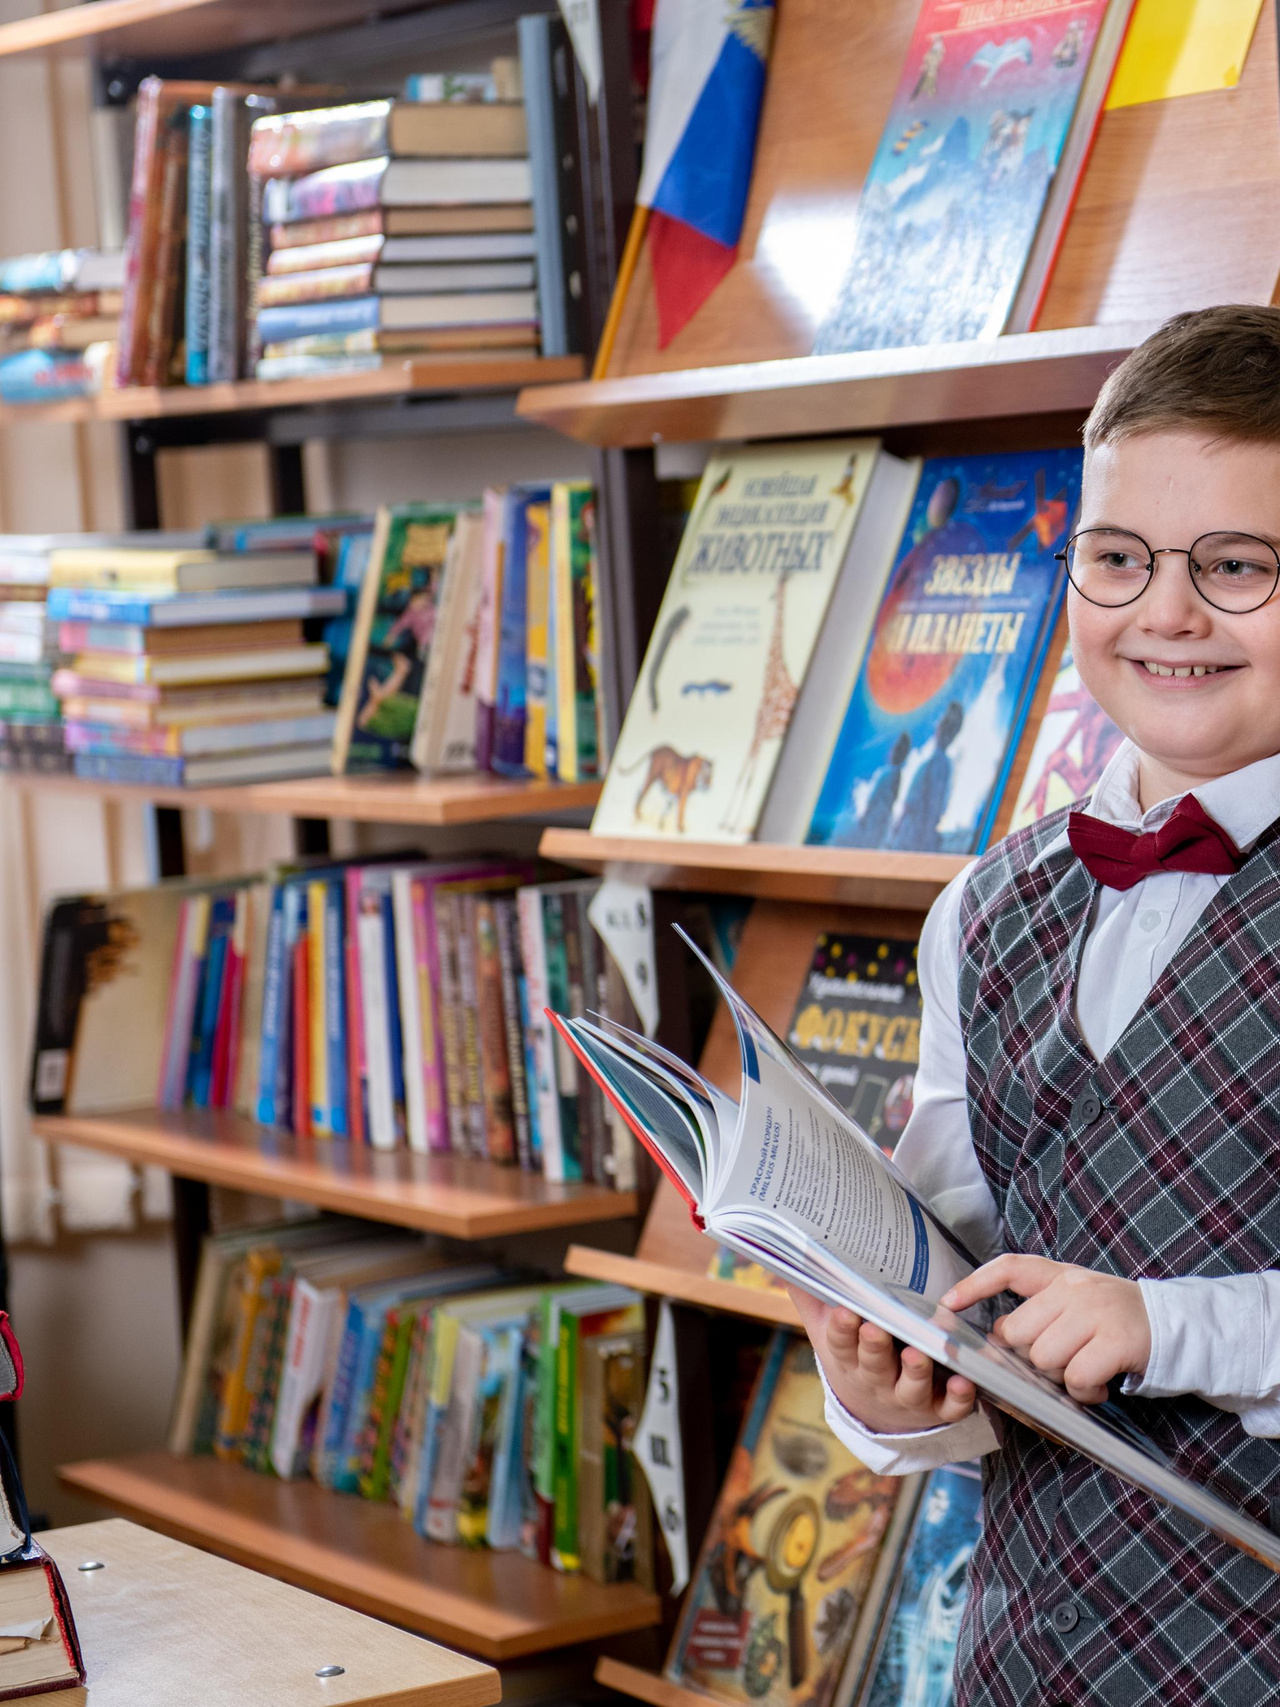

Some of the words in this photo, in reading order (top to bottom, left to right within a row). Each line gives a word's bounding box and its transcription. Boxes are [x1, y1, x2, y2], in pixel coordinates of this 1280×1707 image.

[748, 1147, 768, 1196] КРАСНЫЙ
[761, 1105, 772, 1147] КОРШУН
[757, 1160, 775, 1201] (MILVUS
[769, 1121, 781, 1160] MILVUS)
